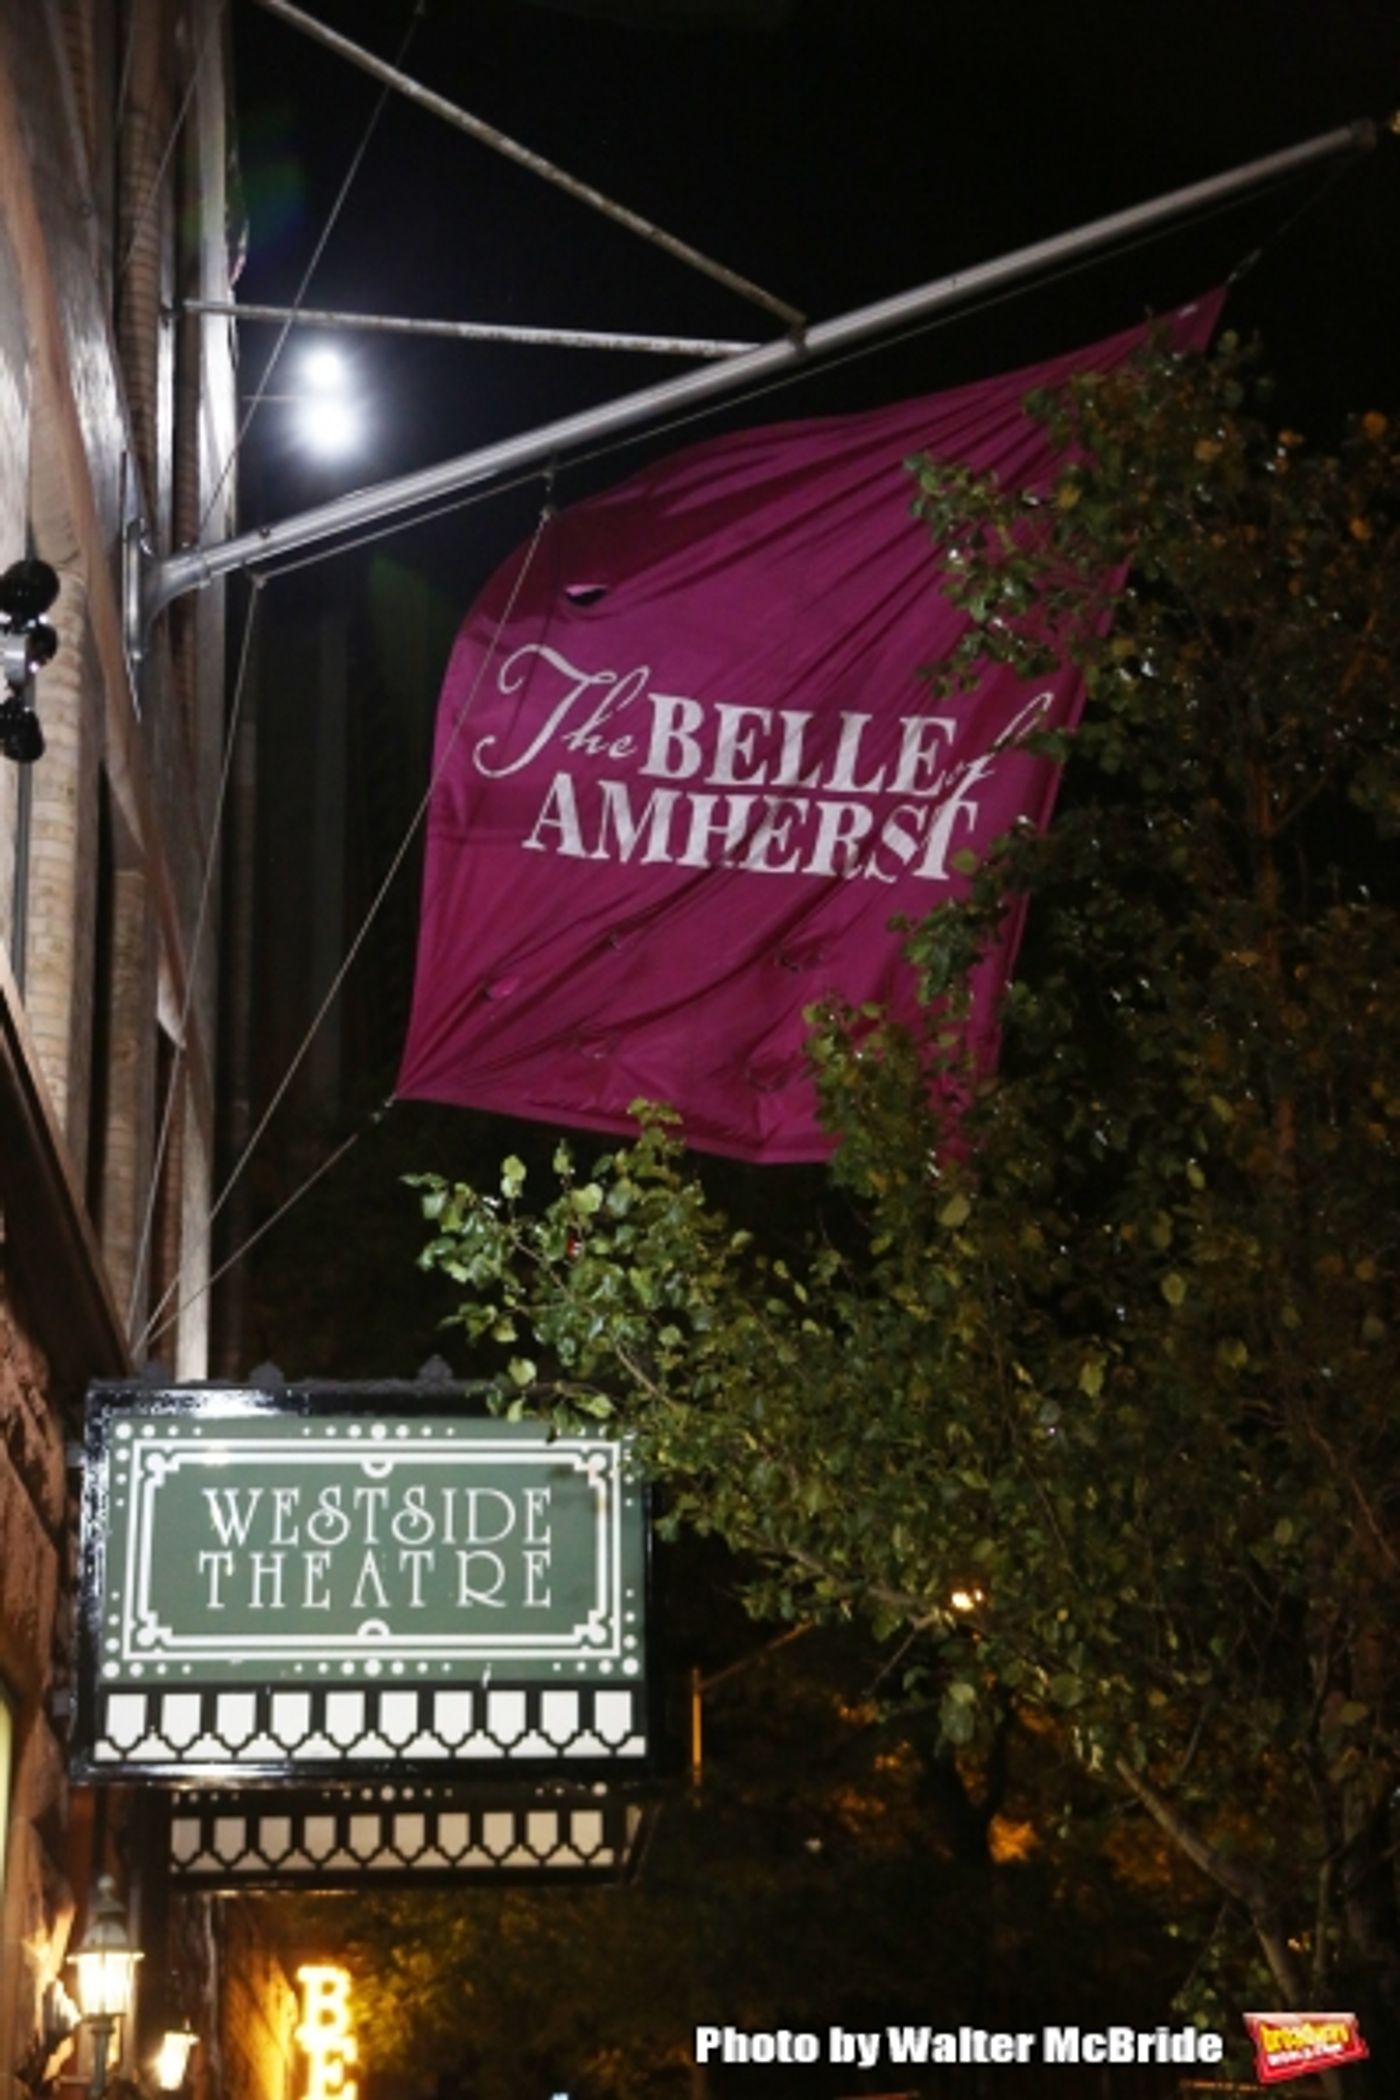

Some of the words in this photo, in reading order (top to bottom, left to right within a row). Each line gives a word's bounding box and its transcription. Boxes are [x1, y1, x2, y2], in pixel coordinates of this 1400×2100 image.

[473, 643, 650, 778] The
[638, 691, 957, 798] BELLE
[521, 771, 979, 883] AMHERST
[203, 1484, 552, 1546] WESTSIDE
[198, 1549, 552, 1610] THEATRE
